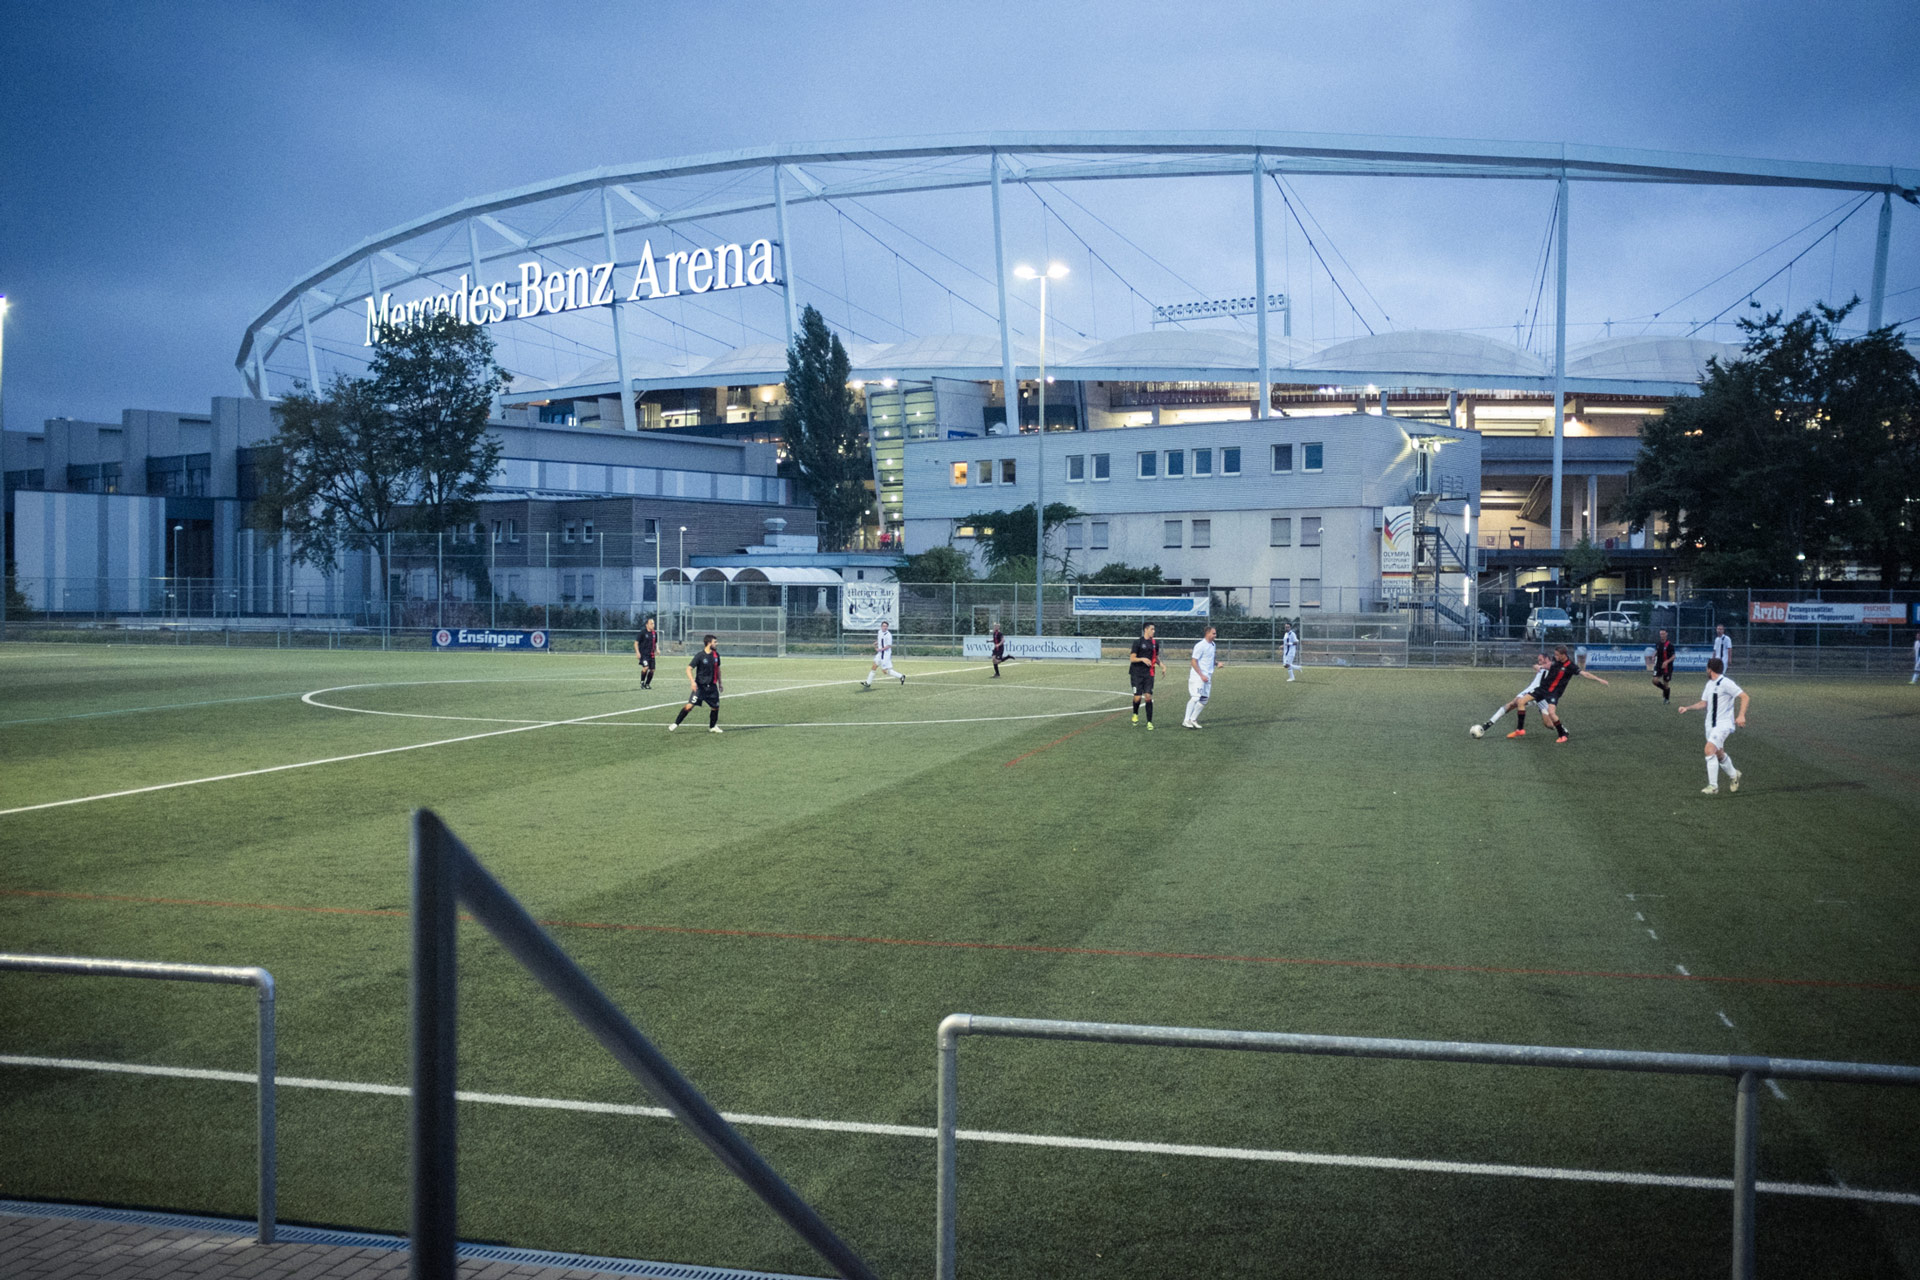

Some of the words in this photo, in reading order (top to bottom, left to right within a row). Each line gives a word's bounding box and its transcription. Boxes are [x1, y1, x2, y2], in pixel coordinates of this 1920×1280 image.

[364, 261, 617, 347] Mercedes-Benz
[627, 238, 778, 301] Arena
[1752, 602, 1785, 620] Ärzte
[458, 629, 524, 647] Ensinger
[966, 641, 1083, 656] wwwthopaedikos.de
[1591, 652, 1641, 663] Weihenstephan
[691, 695, 698, 704] 5
